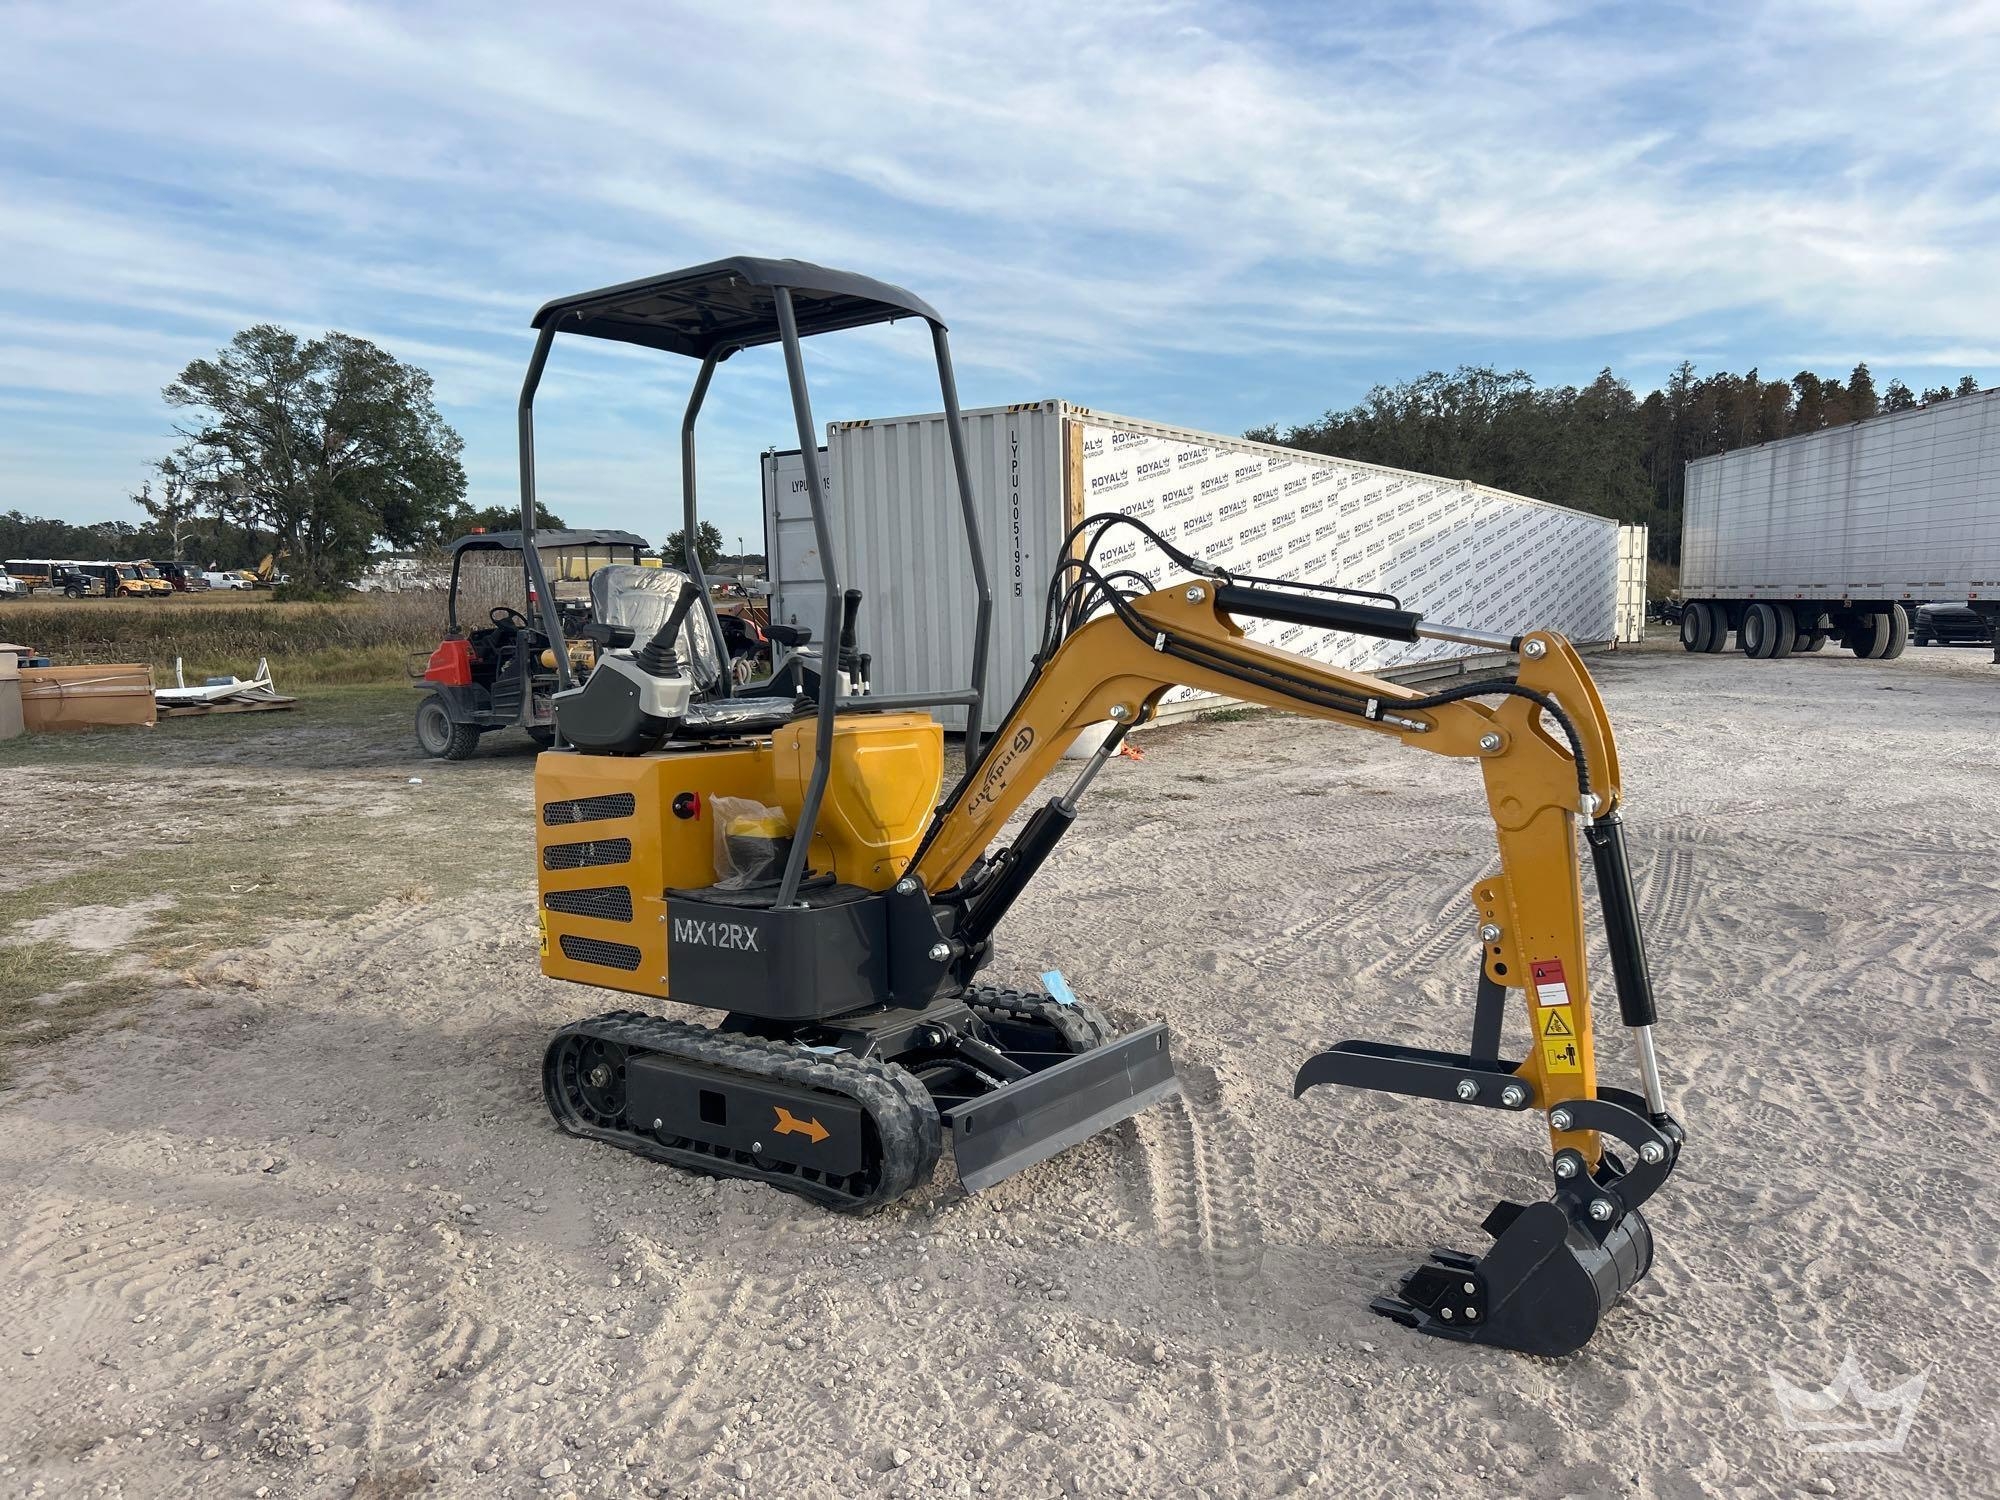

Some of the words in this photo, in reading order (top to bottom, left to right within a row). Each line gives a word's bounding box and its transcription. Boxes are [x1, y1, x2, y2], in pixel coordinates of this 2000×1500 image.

[1011, 430, 1019, 488] LYPU
[1178, 449, 1202, 463] ROYAL
[1137, 460, 1163, 475] ROYAL
[1235, 465, 1256, 478] ROYAL
[1092, 473, 1120, 488] ROYAL
[1312, 470, 1328, 480] ROYAL
[792, 480, 808, 492] LYPU
[1113, 481, 1129, 490] GROUP
[1201, 476, 1222, 490] ROYAL
[1284, 479, 1302, 491] ROYAL
[1163, 487, 1187, 502] ROYAL
[1253, 490, 1273, 503] ROYAL
[1219, 502, 1241, 516] ROYAL
[1301, 501, 1318, 514] ROYAL
[1184, 516, 1206, 530] ROYAL
[1272, 513, 1291, 526] ROYAL
[1013, 493, 1021, 577] 005198
[1240, 525, 1260, 540] ROYAL
[1206, 539, 1227, 554] ROYAL
[1288, 536, 1305, 549] ROYAL
[1100, 545, 1128, 562] ROYAL
[1257, 549, 1277, 563] ROYAL
[1304, 557, 1322, 570] ROYAL
[1128, 570, 1154, 588] ROAL
[1015, 584, 1022, 596] 5
[1281, 626, 1298, 640] ROYAL
[674, 918, 759, 952] MX12RX
